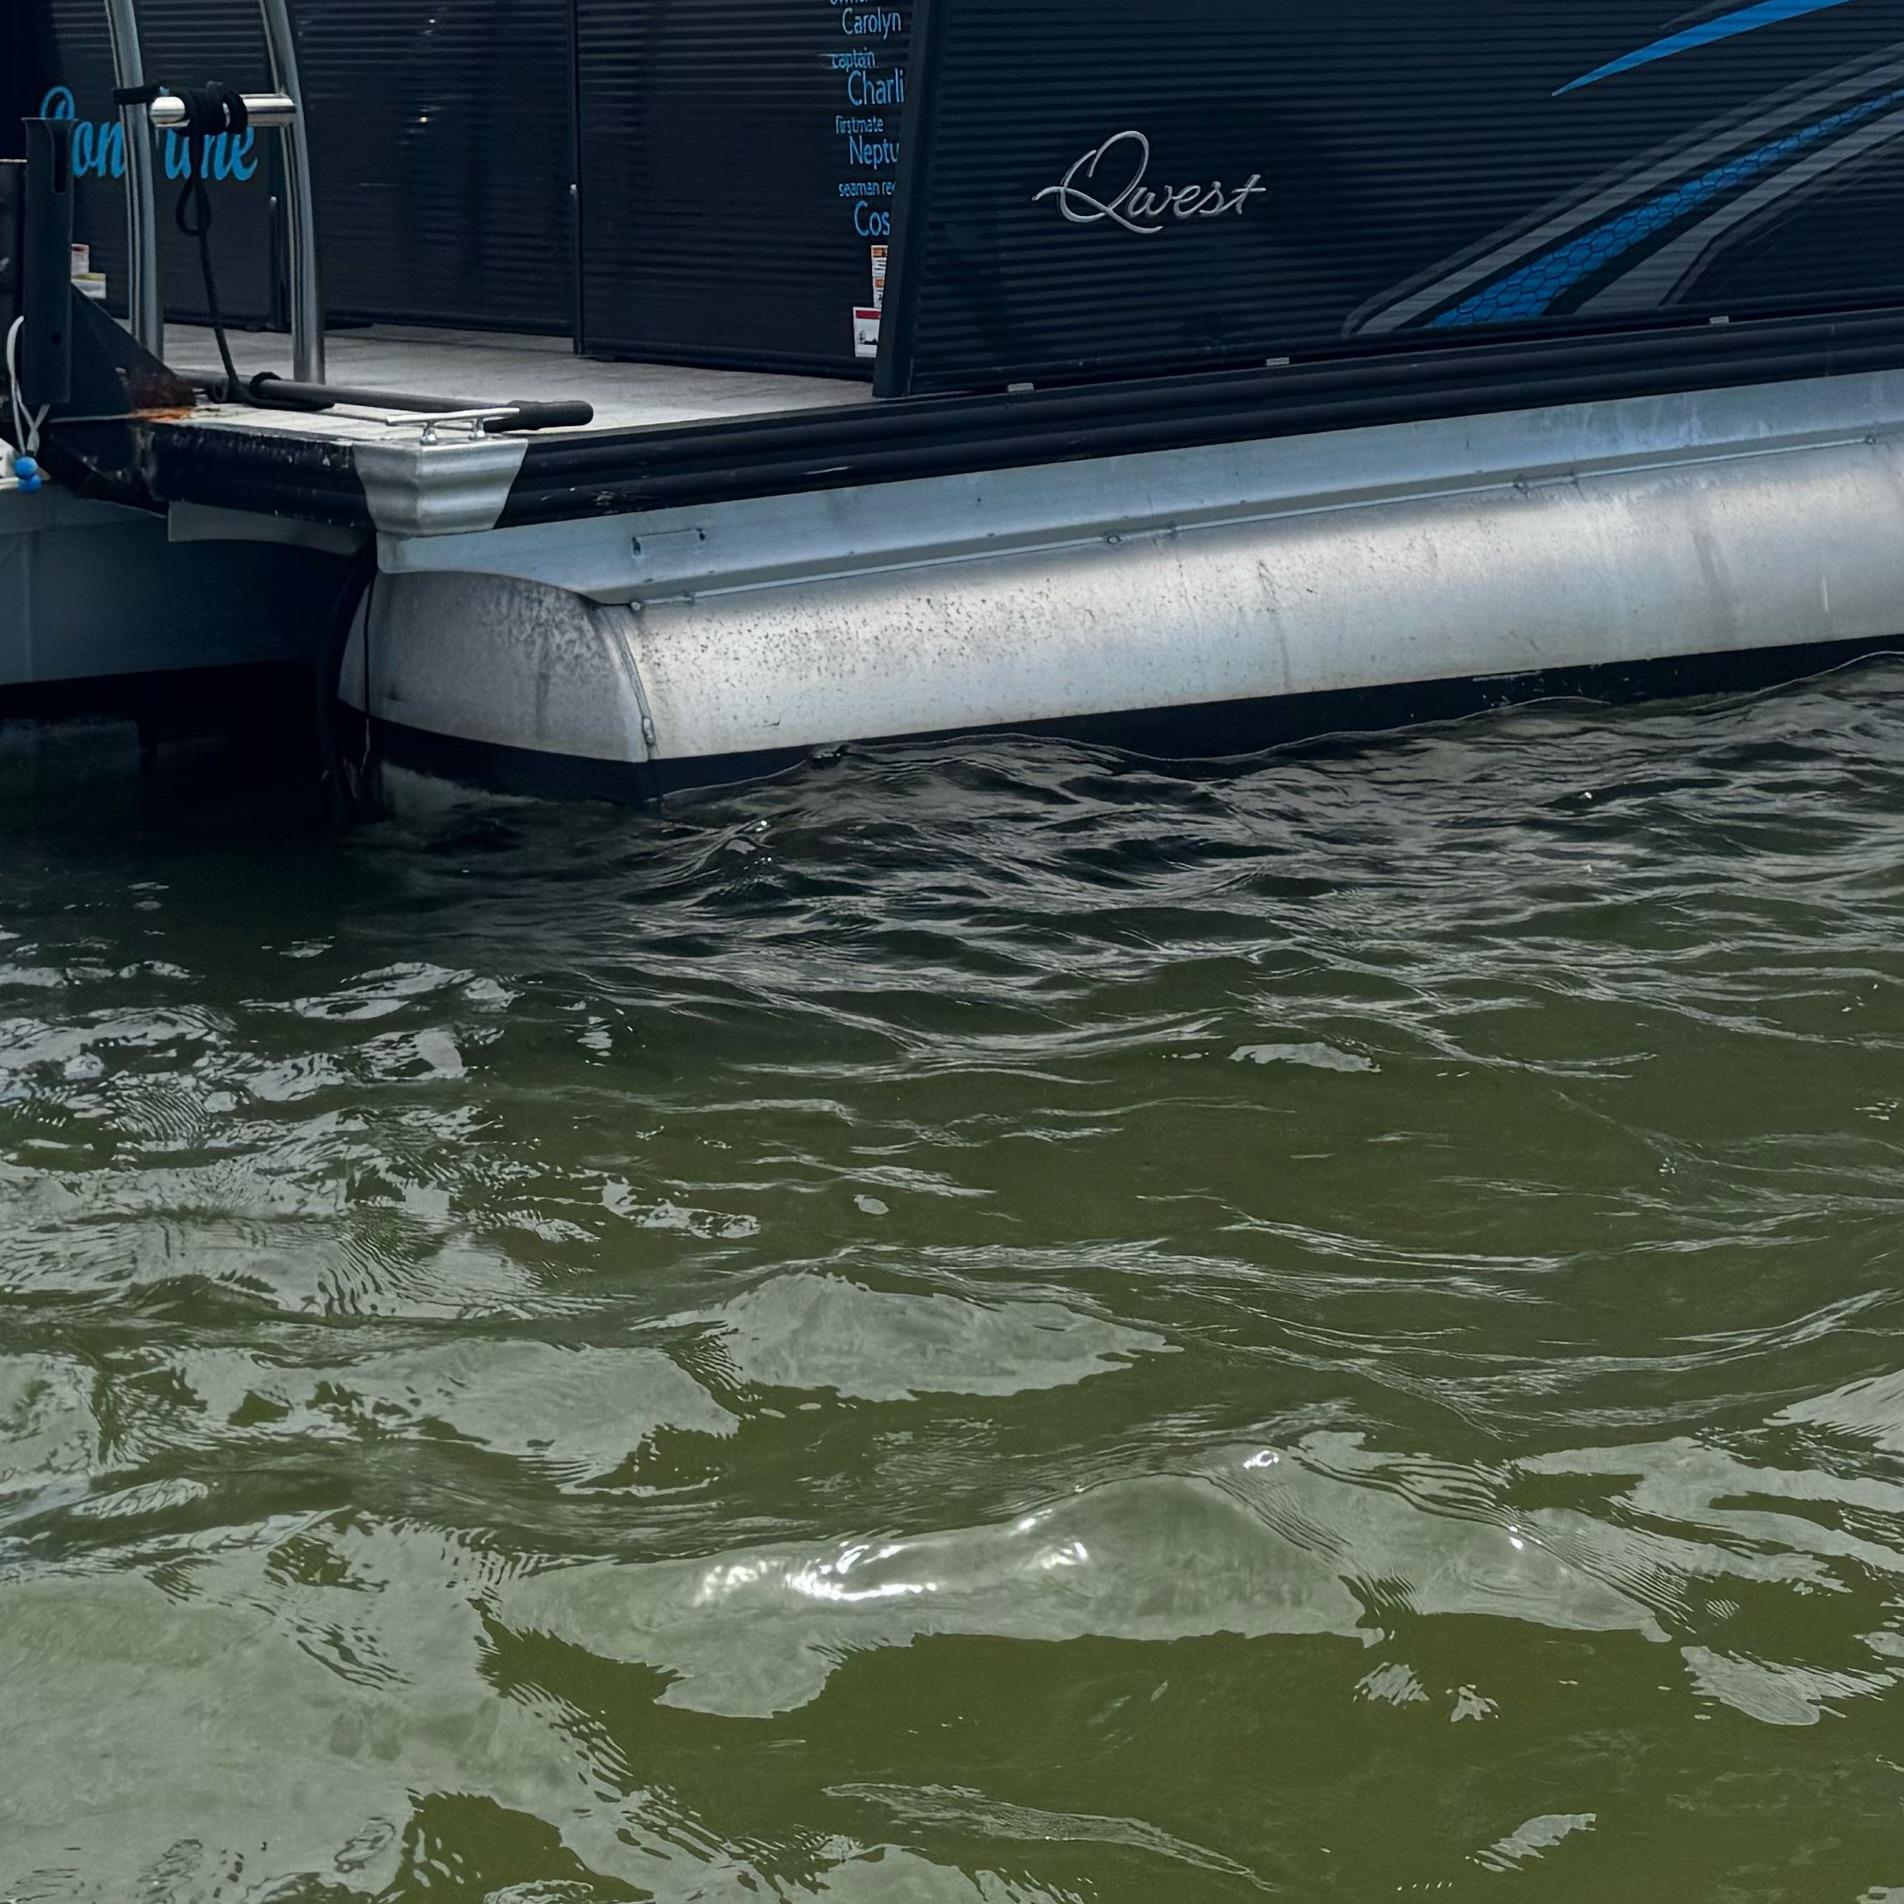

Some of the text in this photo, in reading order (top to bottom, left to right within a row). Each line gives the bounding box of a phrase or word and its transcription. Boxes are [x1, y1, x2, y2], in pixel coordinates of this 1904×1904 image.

[842, 7, 902, 40] Carolyn
[831, 47, 876, 73] captain
[838, 182, 880, 197] seaman
[1031, 130, 1267, 234] Qwest
[854, 200, 891, 237] Cos
